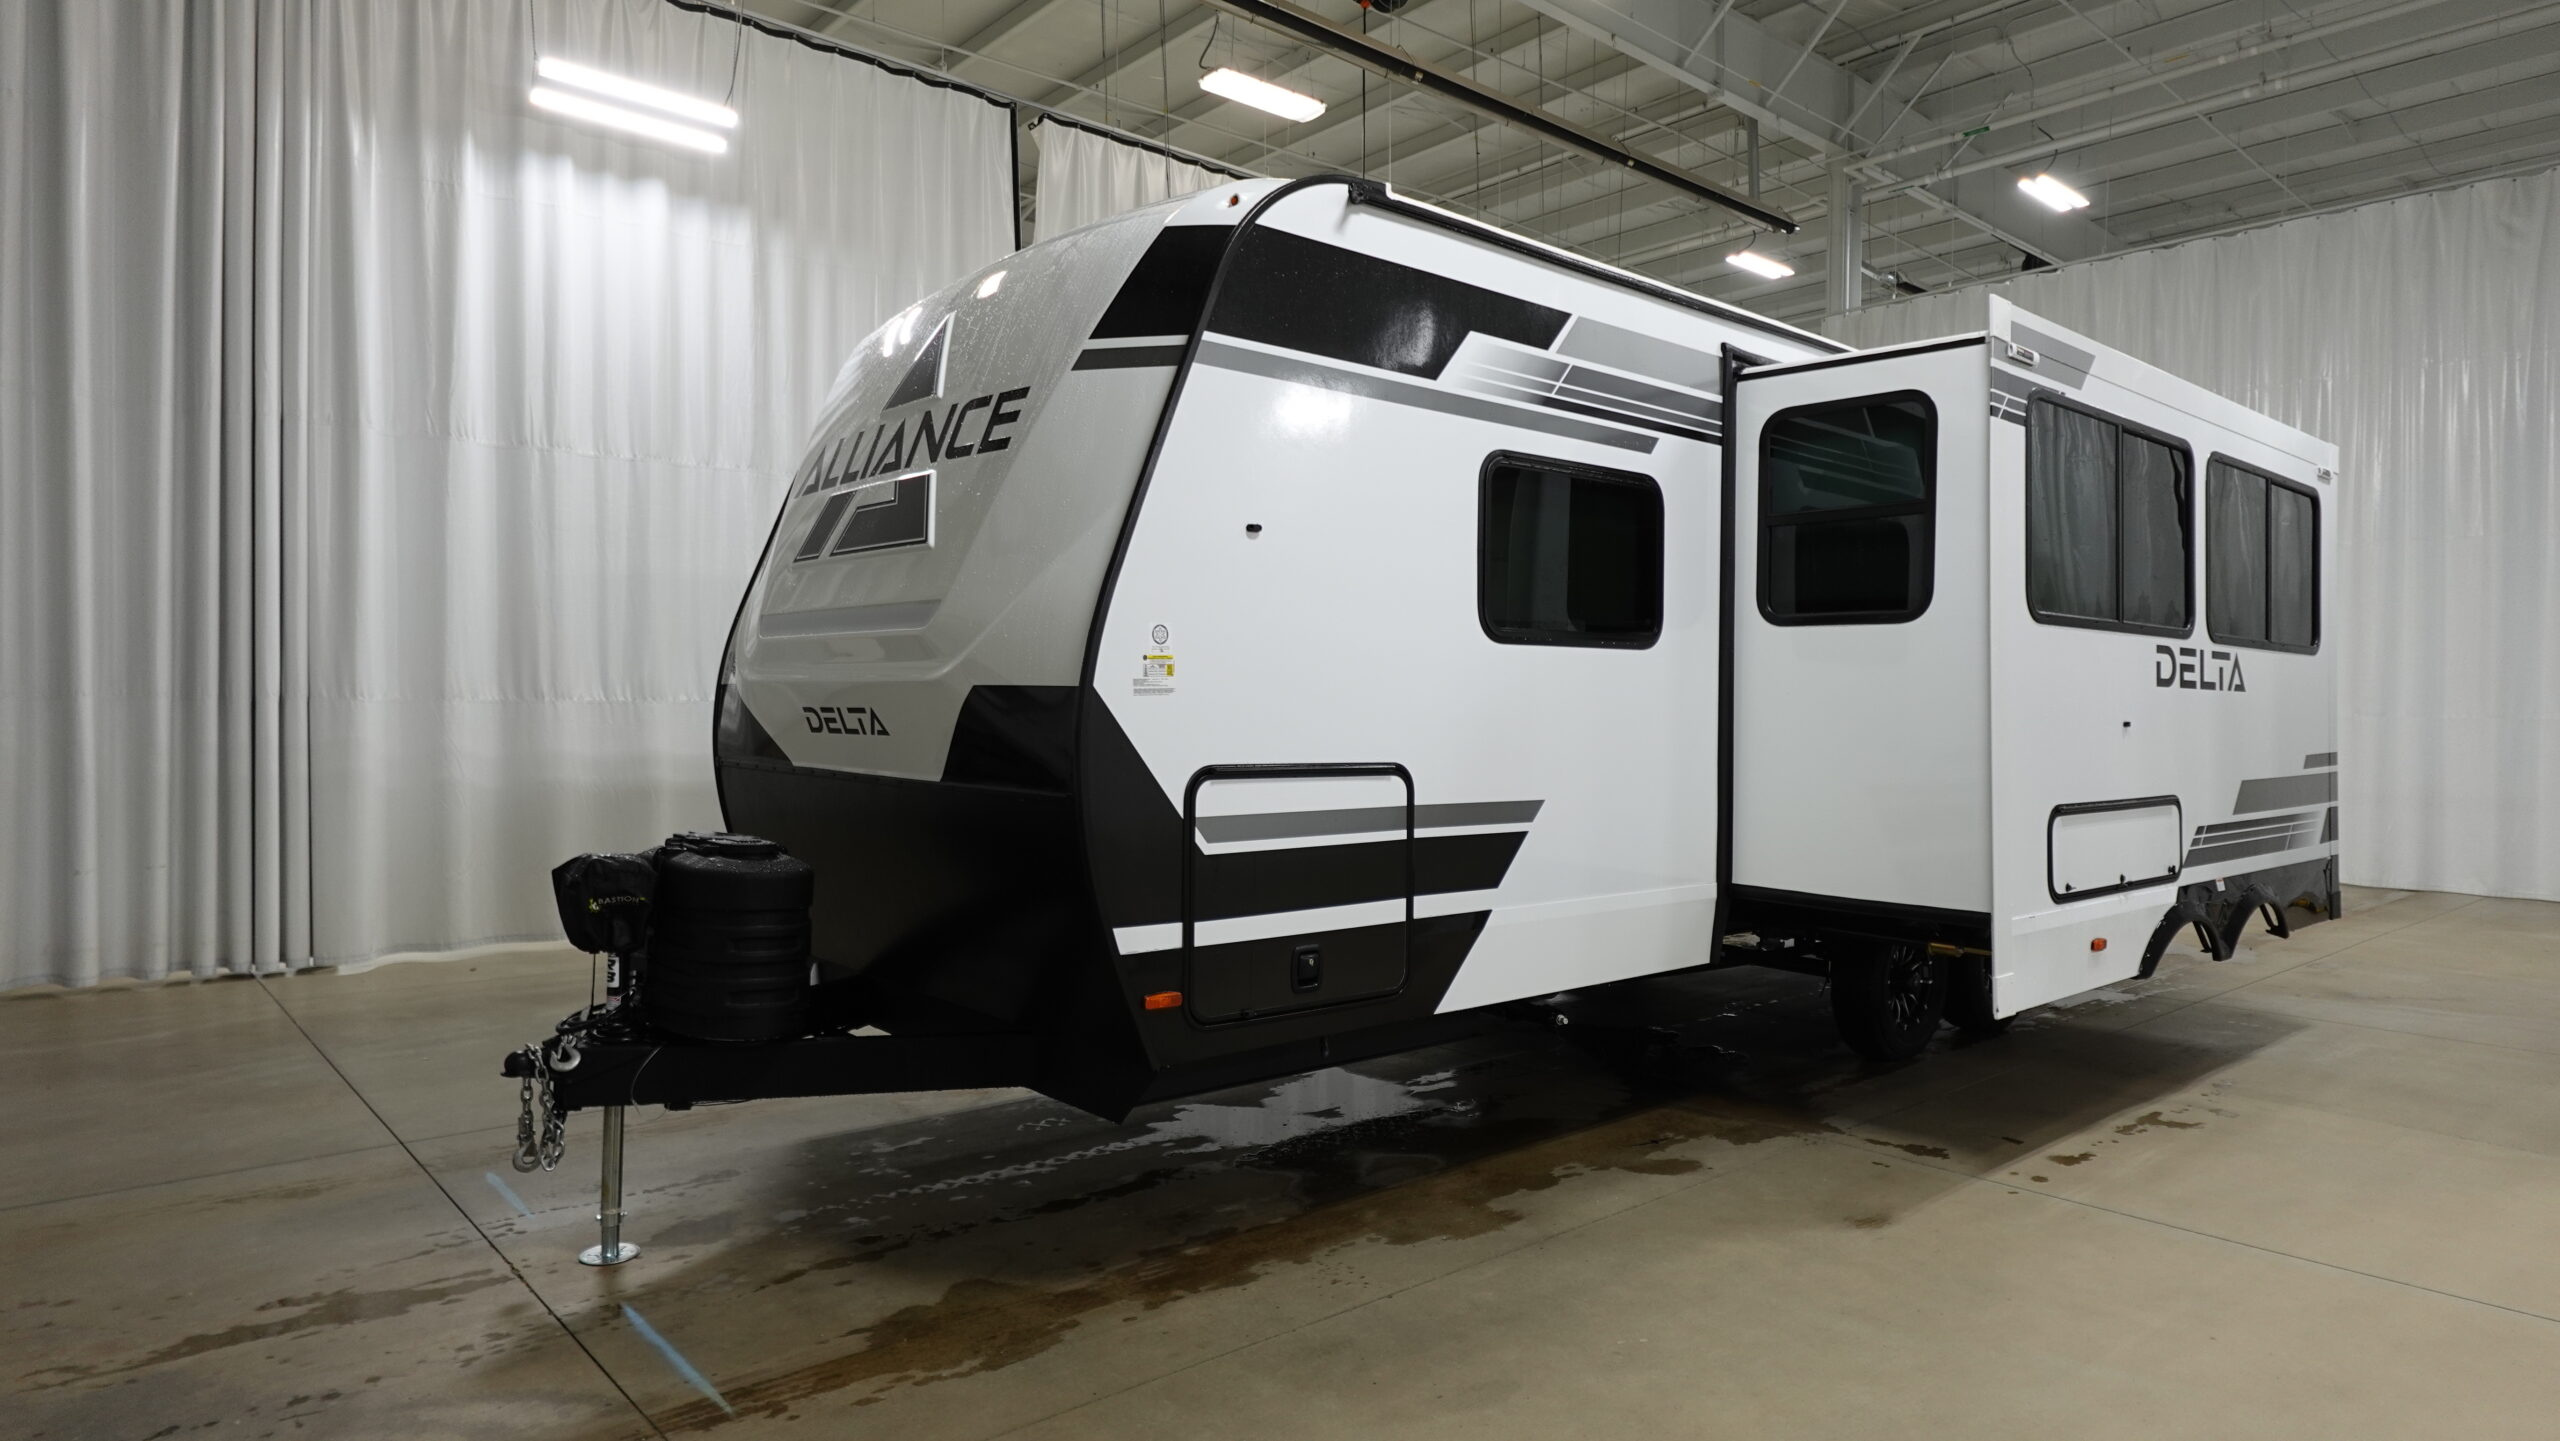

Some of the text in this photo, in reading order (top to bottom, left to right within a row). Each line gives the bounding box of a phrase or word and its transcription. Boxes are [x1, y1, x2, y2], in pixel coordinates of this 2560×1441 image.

[794, 386, 1031, 499] ALLIANCE
[2156, 644, 2247, 692] DELTA
[802, 707, 891, 736] DELTA
